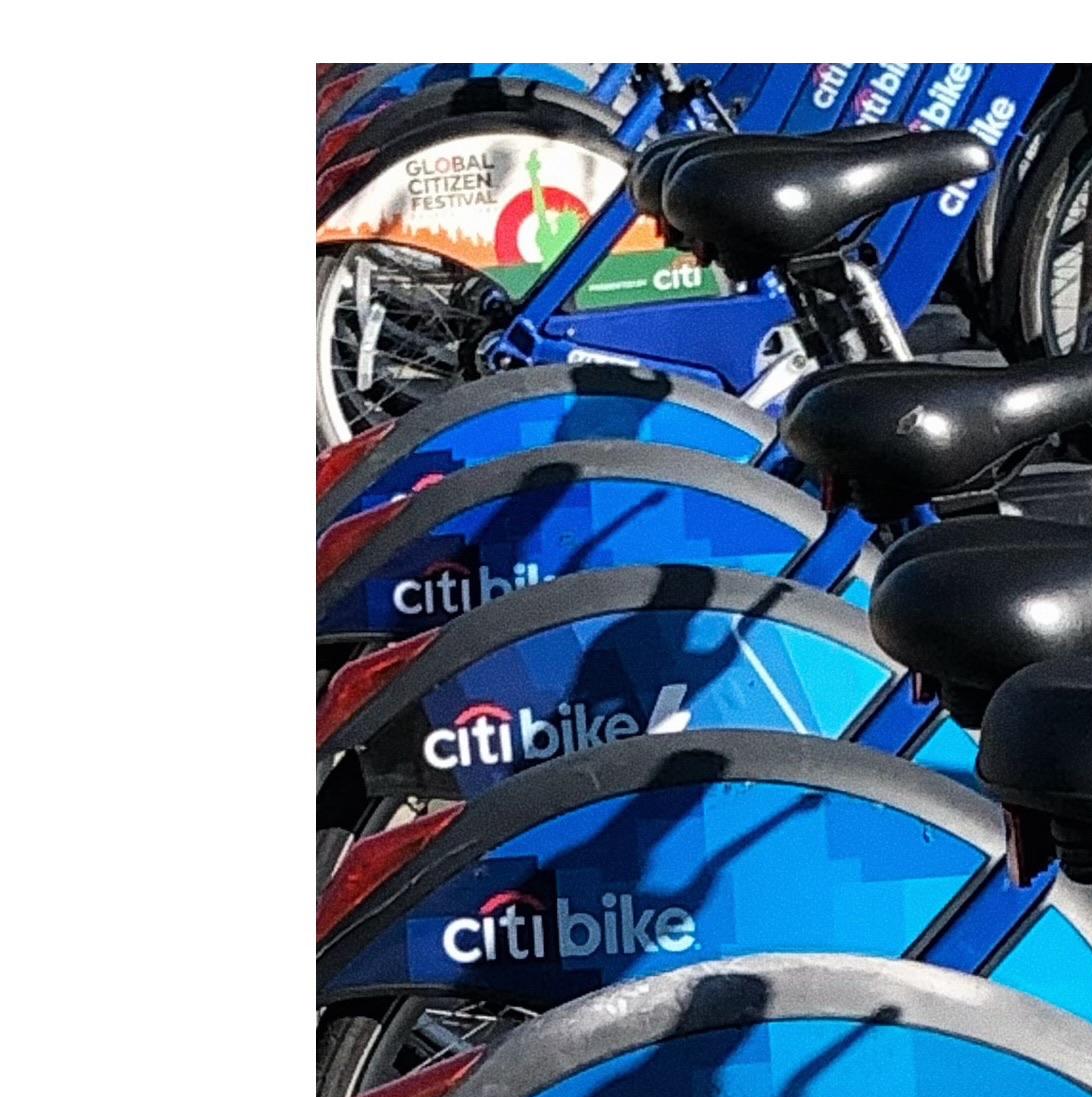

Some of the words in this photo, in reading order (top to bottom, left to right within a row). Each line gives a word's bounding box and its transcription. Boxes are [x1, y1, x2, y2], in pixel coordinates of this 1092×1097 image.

[918, 63, 973, 128] bike
[968, 96, 1016, 146] ike
[406, 153, 496, 176] GLOBAL
[408, 173, 493, 195] CITIZEN
[411, 190, 498, 211] FESTIVAL
[652, 254, 702, 291] citi
[393, 561, 472, 614] citi
[423, 704, 514, 769] citi
[519, 703, 640, 759] bike
[443, 890, 545, 963] citi
[556, 892, 697, 958] bike
